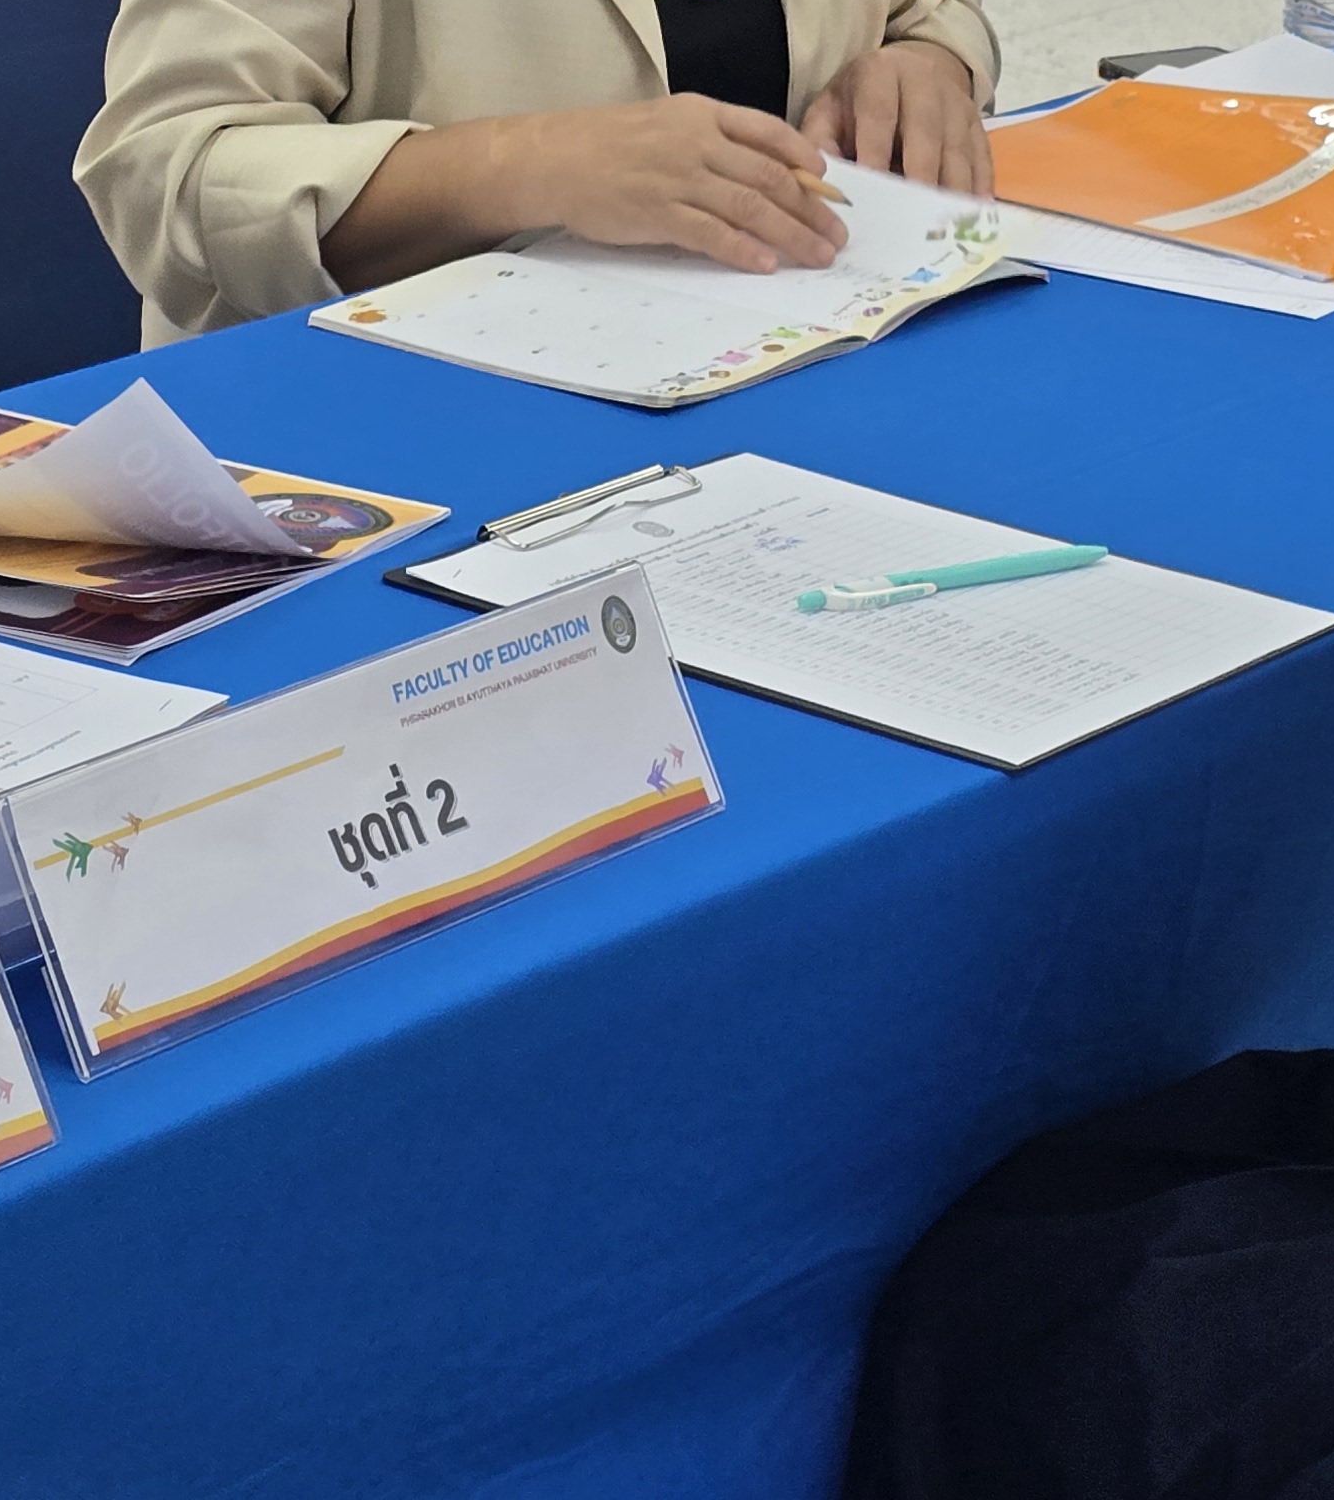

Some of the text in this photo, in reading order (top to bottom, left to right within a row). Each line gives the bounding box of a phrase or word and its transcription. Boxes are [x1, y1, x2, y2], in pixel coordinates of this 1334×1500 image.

[392, 615, 591, 703] FACULTY OF EDUCATION
[553, 646, 598, 671] UNIVERSITY
[327, 762, 471, 890] ชุดที่ 2
